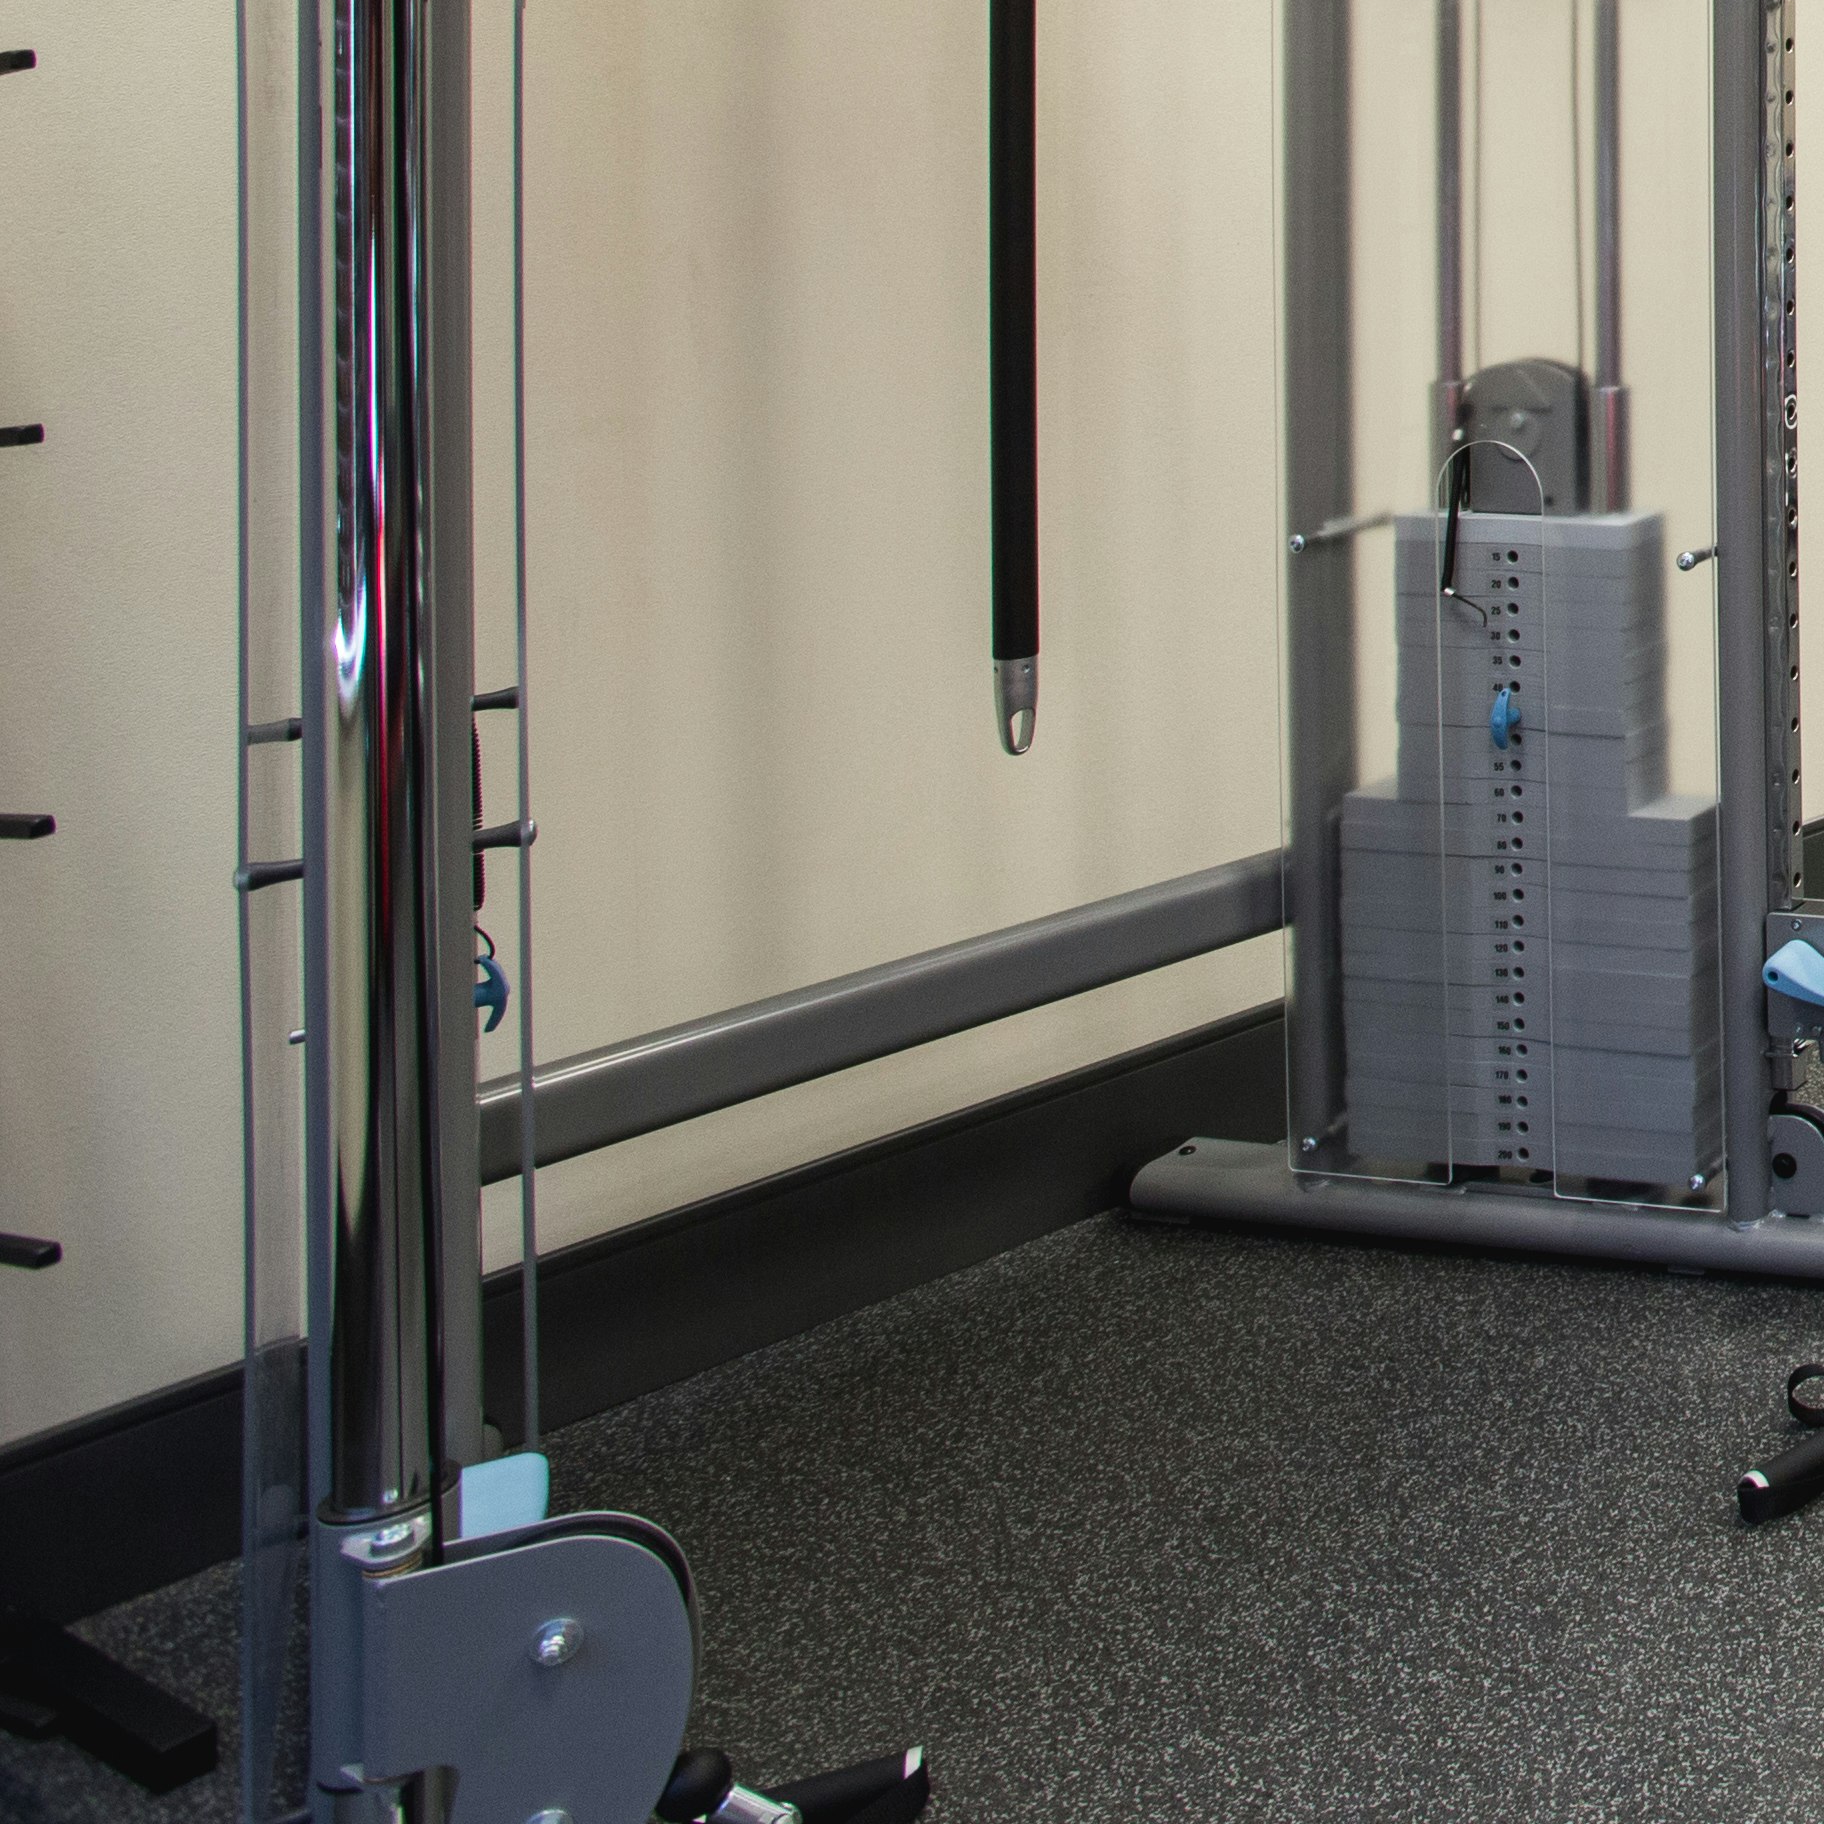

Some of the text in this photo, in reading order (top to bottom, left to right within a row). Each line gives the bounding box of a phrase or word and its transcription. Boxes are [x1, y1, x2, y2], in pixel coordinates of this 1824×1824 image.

[1491, 579, 1501, 589] 20
[1490, 606, 1501, 616] 25
[1492, 656, 1503, 665] 35
[1493, 762, 1504, 771] 55
[1497, 813, 1507, 823] 70
[1494, 920, 1508, 930] 110
[1494, 943, 1508, 953] 120
[1495, 1070, 1509, 1080] 170
[1498, 1150, 1512, 1160] 200
